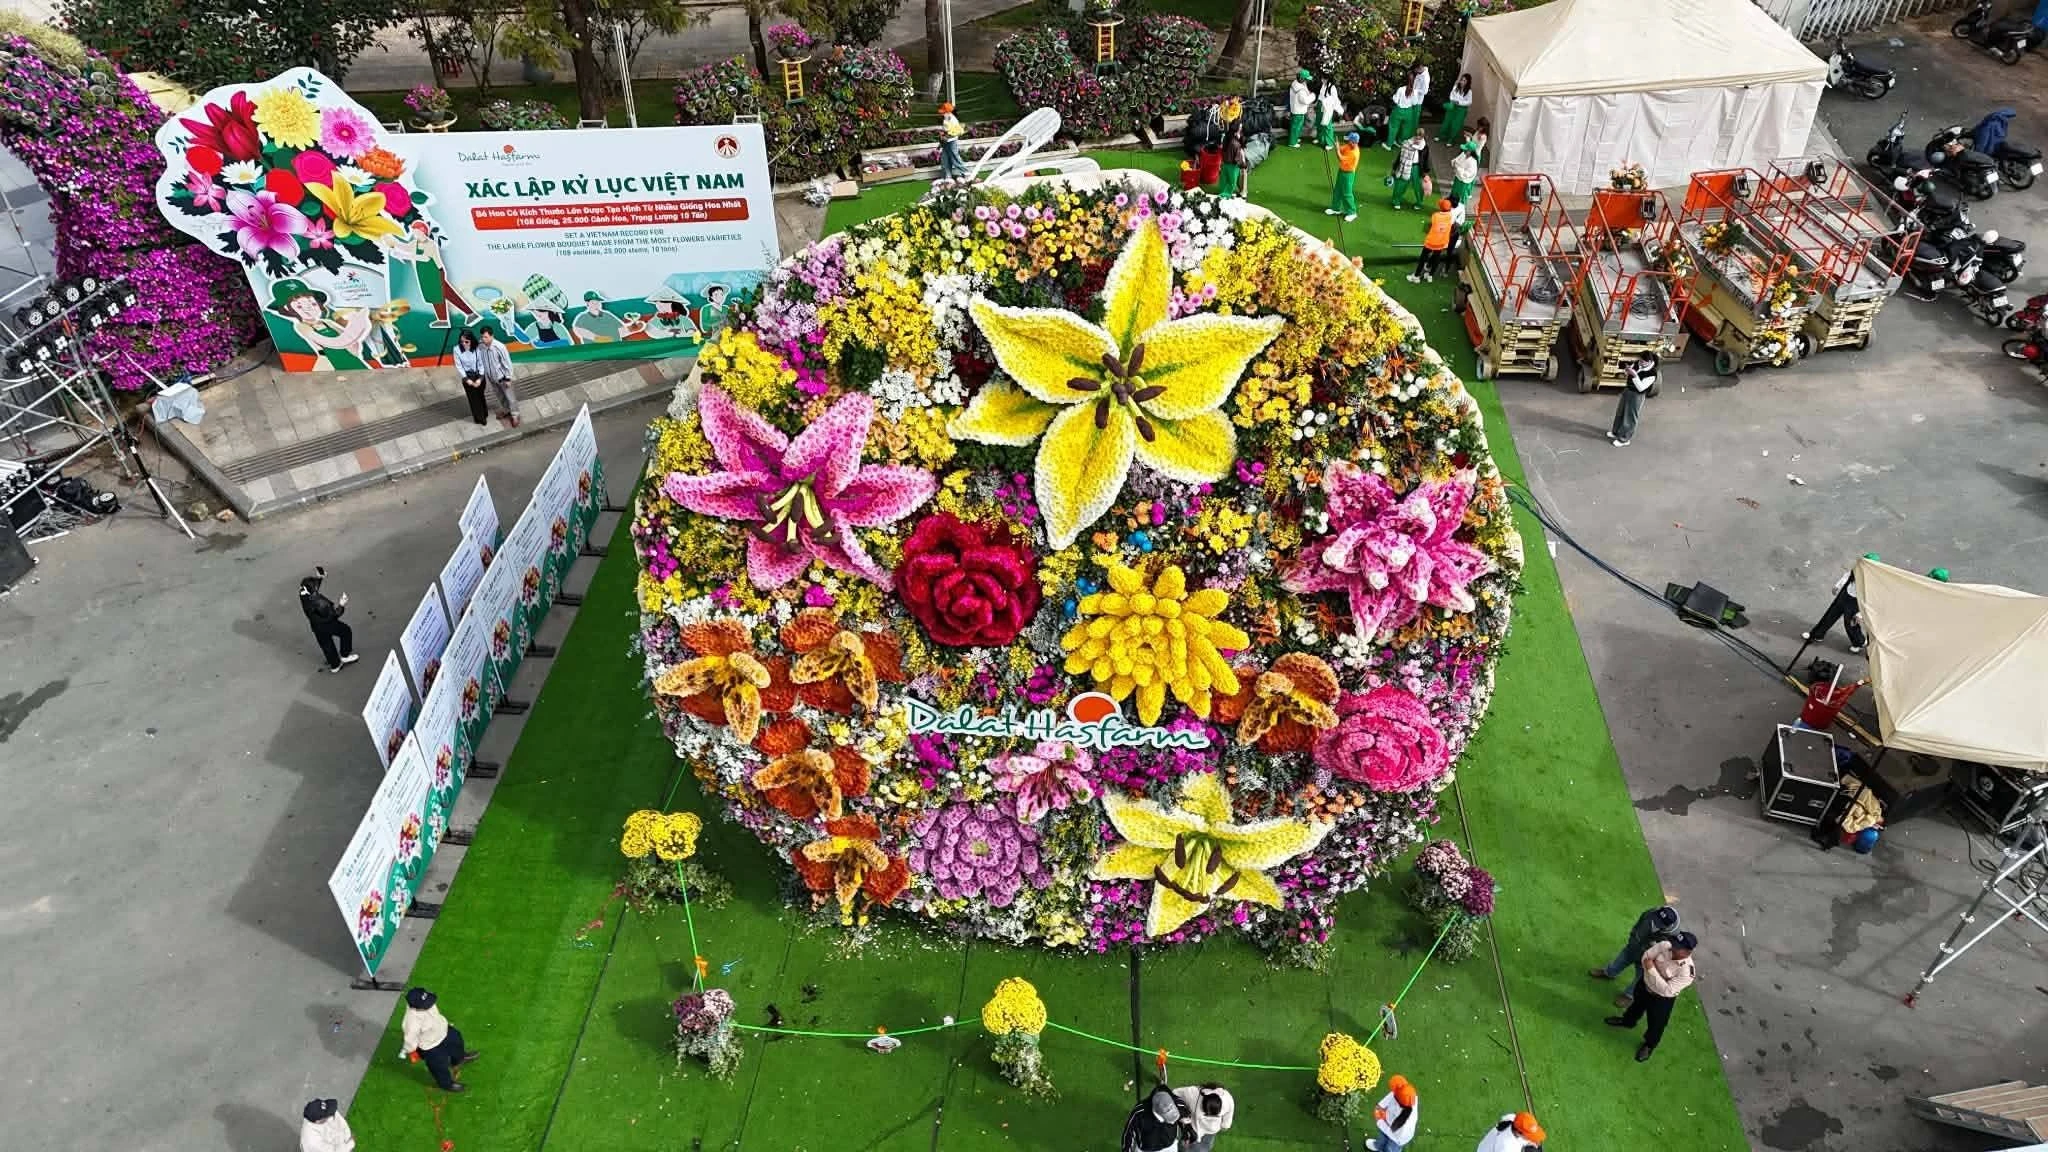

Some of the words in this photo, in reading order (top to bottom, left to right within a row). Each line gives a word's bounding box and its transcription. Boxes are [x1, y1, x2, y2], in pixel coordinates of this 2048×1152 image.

[458, 151, 488, 162] Dalat
[492, 150, 540, 162] Hasfarm
[465, 178, 510, 198] XÁC
[514, 176, 556, 201] LẬP
[562, 173, 589, 195] KỶ
[595, 176, 638, 199] LỤC
[641, 172, 690, 196] VIỆT
[696, 173, 745, 190] NAM
[476, 209, 487, 218] Bó
[489, 209, 505, 217] Hoa
[507, 208, 518, 217] Có
[520, 208, 538, 216] Kích
[539, 207, 565, 216] Thước
[566, 207, 582, 215] Lớn
[583, 206, 604, 215] Được
[605, 205, 620, 214] Tạo
[622, 204, 641, 213] Hình
[655, 202, 678, 211] Nhiều
[680, 202, 704, 211] Giống
[705, 201, 720, 209] Hoa
[722, 200, 741, 209] Nhất
[562, 216, 589, 224] 25.000
[591, 215, 610, 223] Cành
[630, 214, 653, 223] Trọng
[655, 213, 678, 222] Lượng
[502, 242, 527, 250] LARGE
[527, 241, 556, 249] FLOWER
[557, 240, 590, 248] BOUQUET
[591, 239, 613, 247] MADE
[672, 235, 705, 243] FLOWERS
[706, 233, 742, 241] VARIETIES
[620, 229, 649, 237] RECORD
[907, 699, 1015, 734] Dalat
[1024, 710, 1206, 749] Hasfarm
